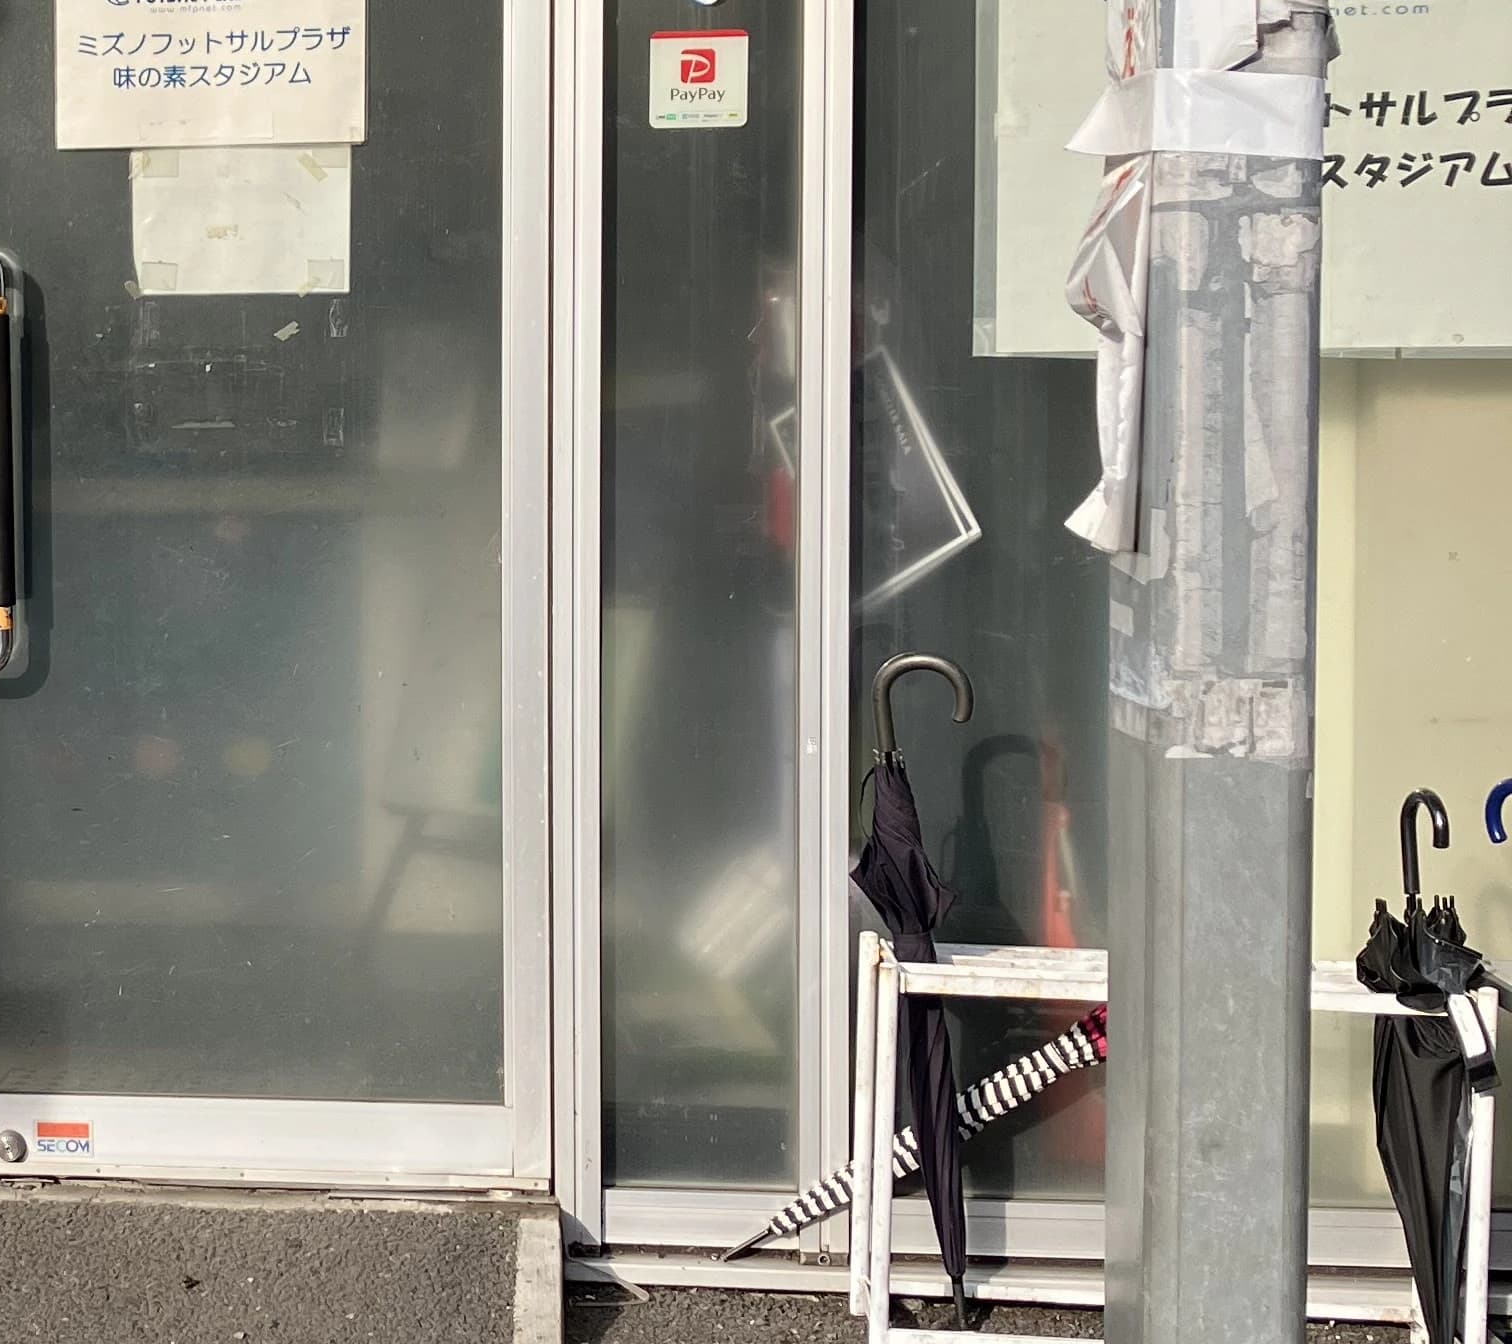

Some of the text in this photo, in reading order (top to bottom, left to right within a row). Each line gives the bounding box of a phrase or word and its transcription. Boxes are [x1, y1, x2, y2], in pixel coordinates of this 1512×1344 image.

[77, 25, 352, 57] ミズノフットサルプラザ
[112, 61, 313, 90] 味の素スタジアム
[670, 87, 726, 104] PayPay
[37, 1139, 90, 1153] SECOM
